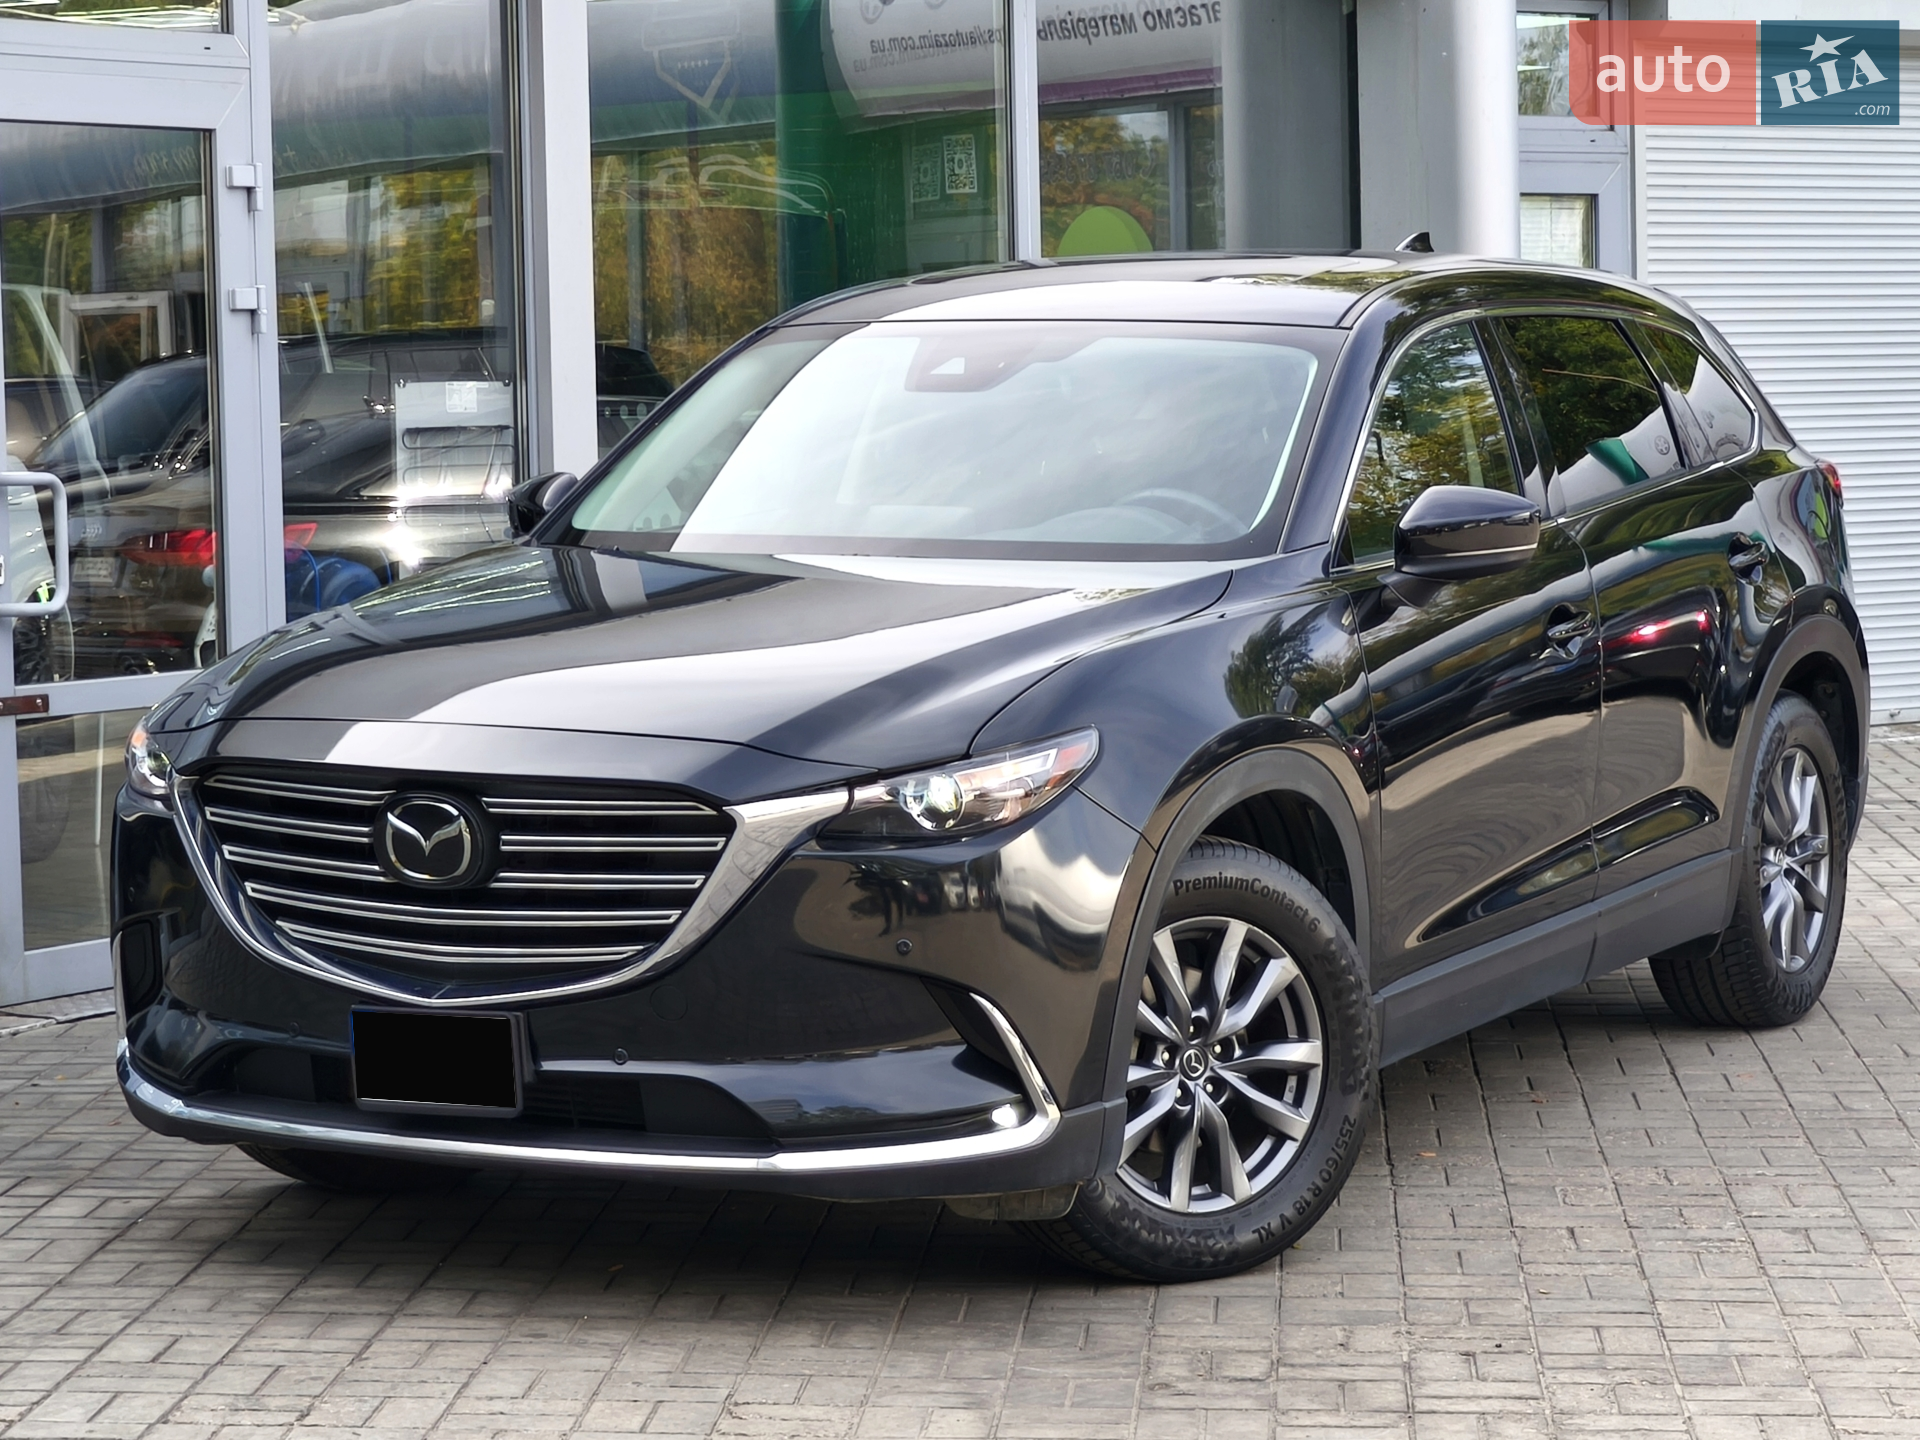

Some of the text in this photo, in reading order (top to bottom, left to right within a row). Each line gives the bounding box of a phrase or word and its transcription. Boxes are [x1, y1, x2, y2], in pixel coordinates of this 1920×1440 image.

[1172, 871, 1321, 933] PremiumContact 6
[1251, 1114, 1357, 1244] 255/60 R 18 V XL
